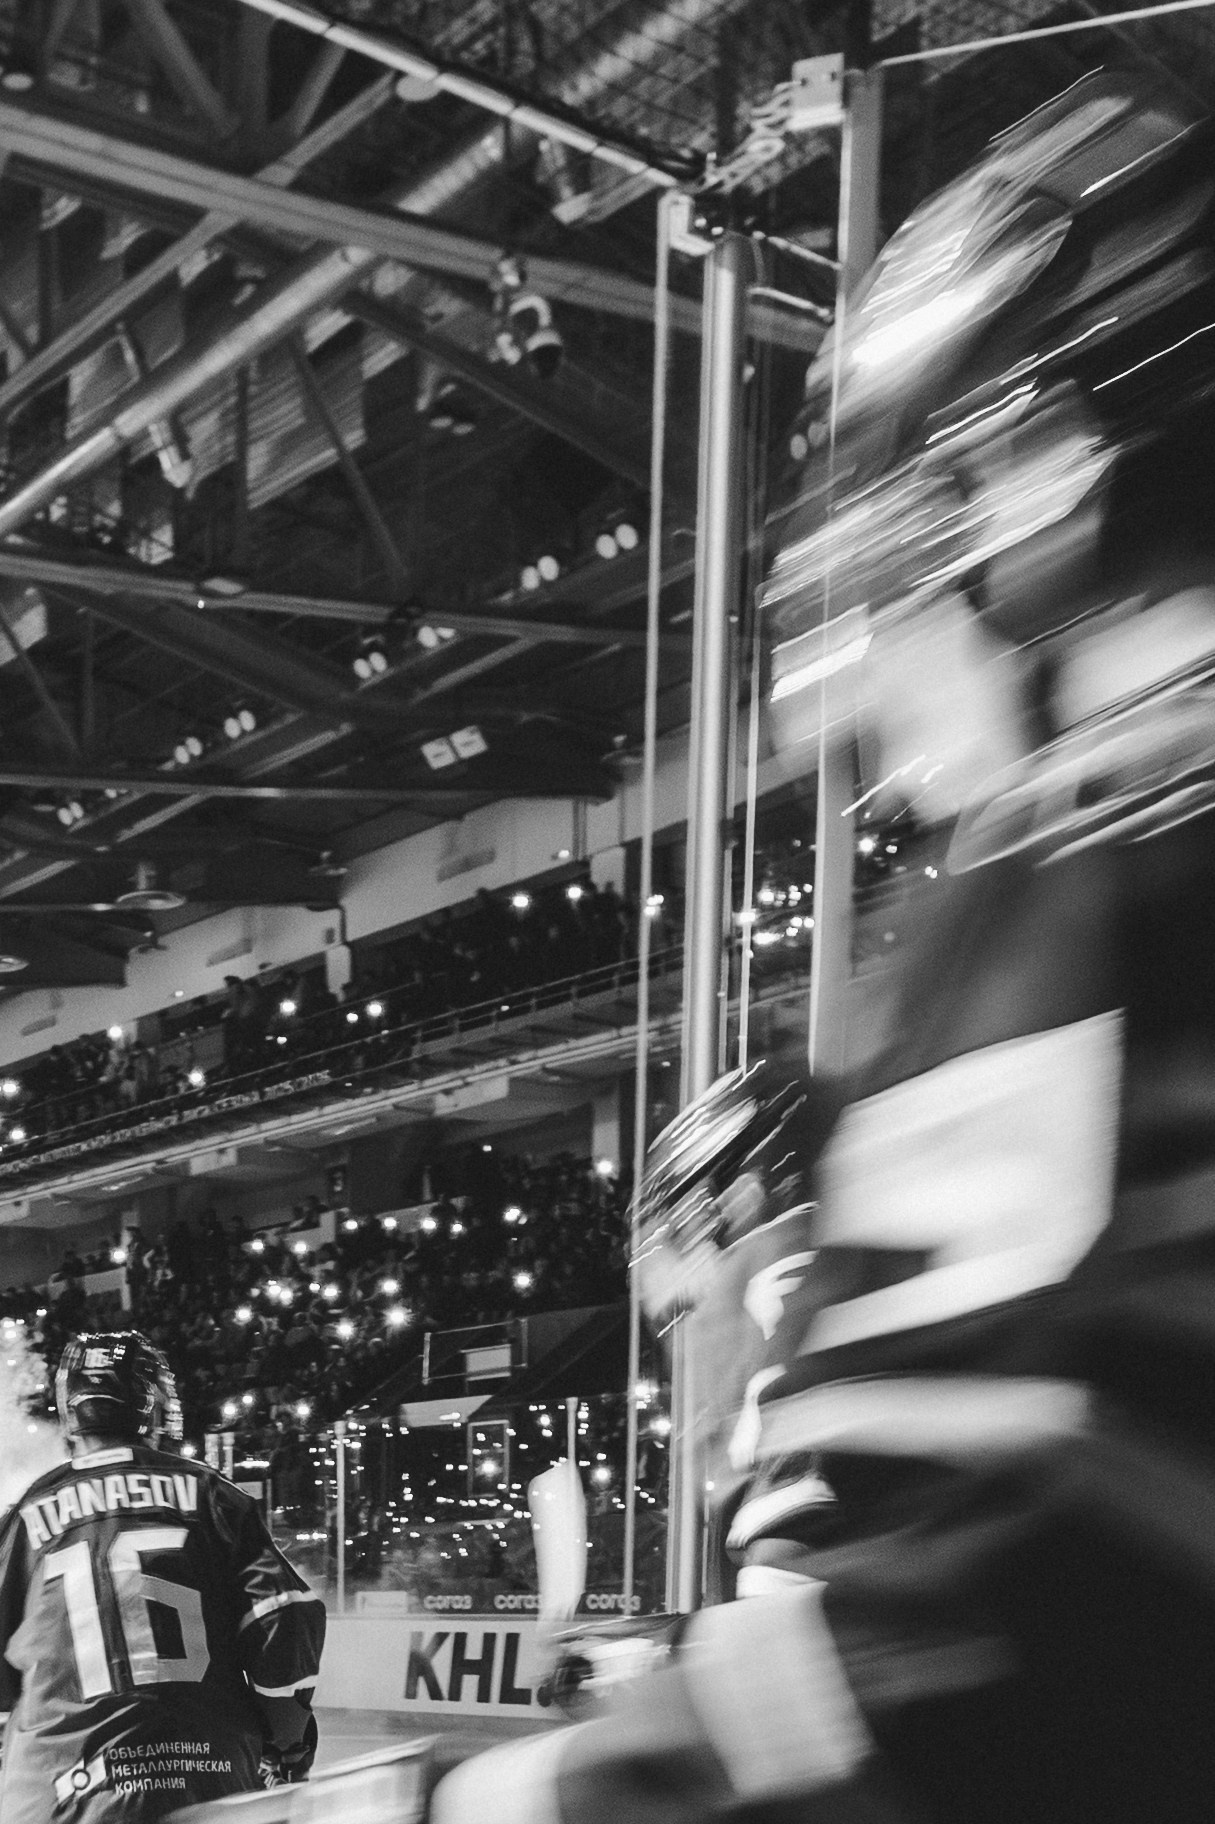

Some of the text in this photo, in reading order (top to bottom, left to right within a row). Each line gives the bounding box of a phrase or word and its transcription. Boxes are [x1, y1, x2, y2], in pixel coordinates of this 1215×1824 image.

[19, 1473, 198, 1550] ATANASOV
[43, 1528, 211, 1700] 16
[404, 1630, 533, 1706] KHL
[108, 1741, 211, 1760] ОБЪЕДИНЕННАЯ
[110, 1759, 232, 1779] МЕТАЛЛУРГИЧЕСКАЯ
[114, 1777, 186, 1796] КОМПАНИЯ
